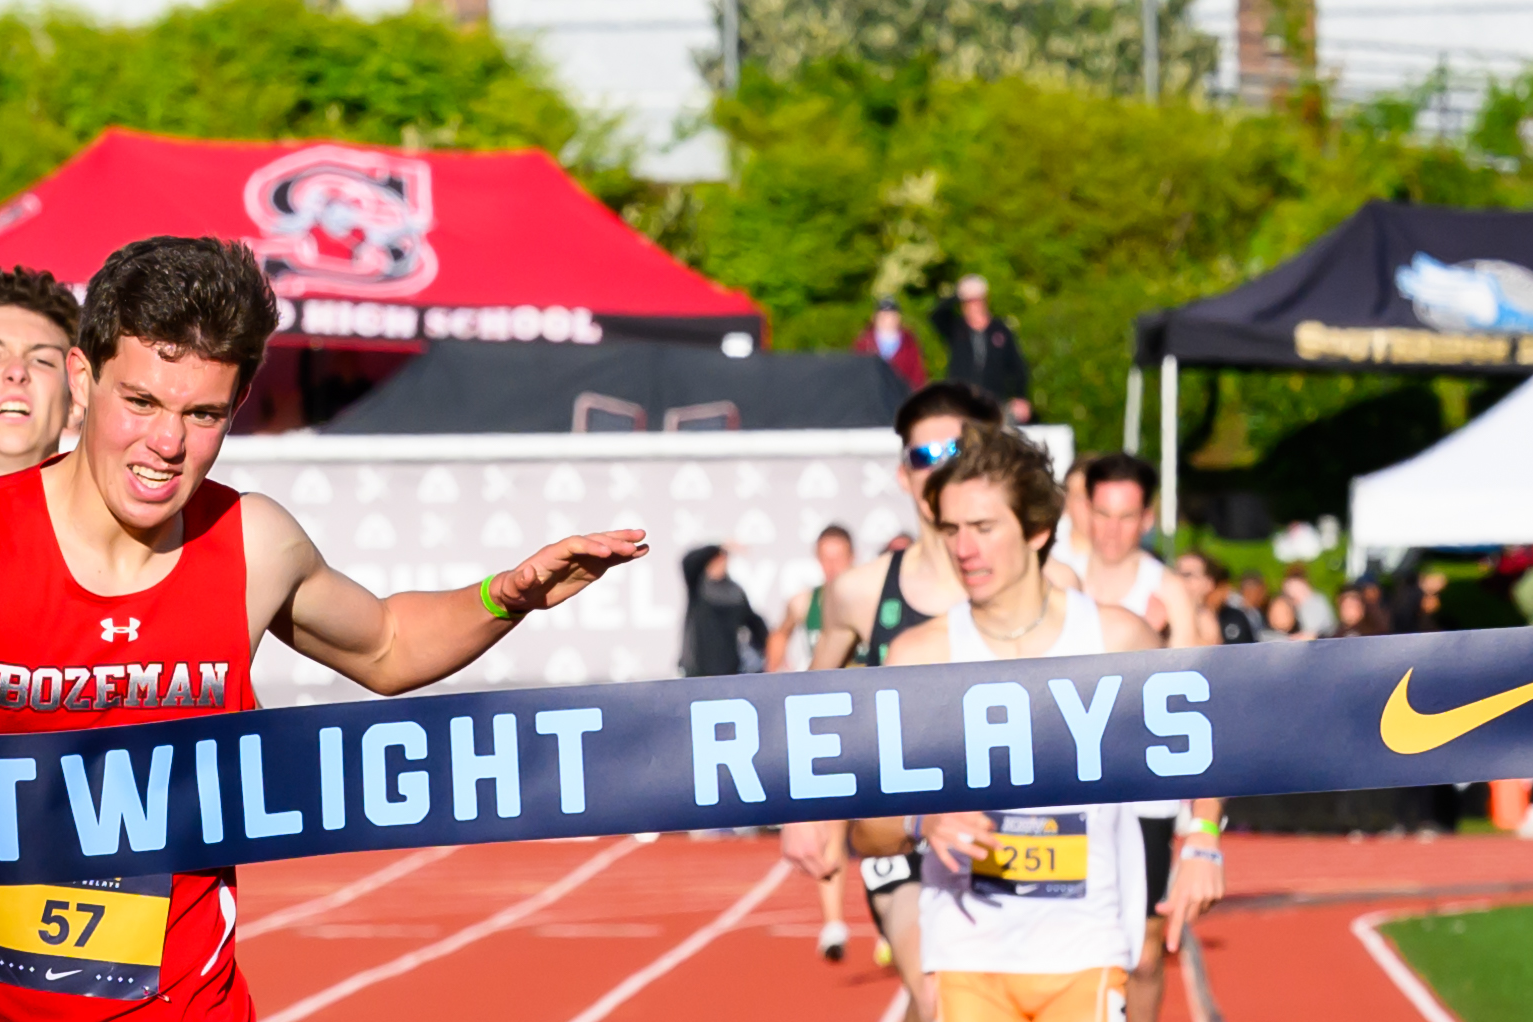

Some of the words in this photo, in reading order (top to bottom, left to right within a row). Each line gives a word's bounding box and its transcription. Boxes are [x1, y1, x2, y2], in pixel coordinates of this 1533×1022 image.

[301, 299, 418, 338] HIGH
[423, 305, 602, 344] SCHOOL
[690, 670, 1213, 806] RELAYS
[1002, 846, 1055, 872] 251
[37, 899, 106, 948] 57
